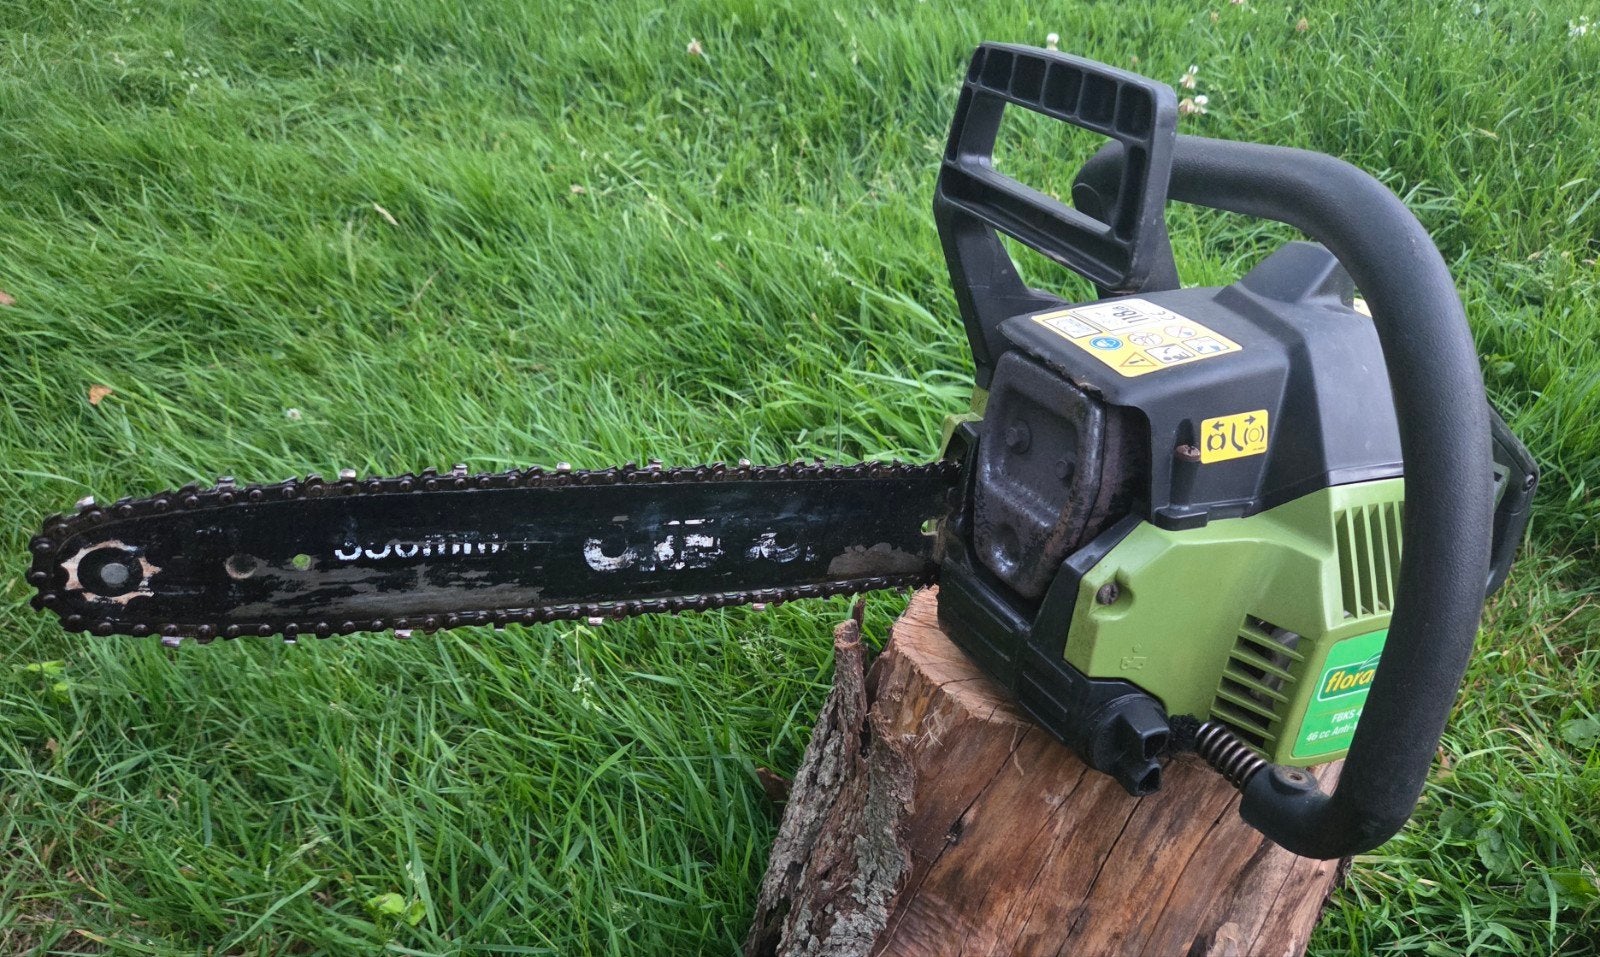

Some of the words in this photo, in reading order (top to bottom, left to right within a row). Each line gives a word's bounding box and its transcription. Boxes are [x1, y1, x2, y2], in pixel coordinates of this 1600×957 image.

[1325, 669, 1376, 693] flora
[1331, 709, 1356, 723] FBKS
[1306, 731, 1319, 742] 46
[1319, 730, 1331, 739] cc
